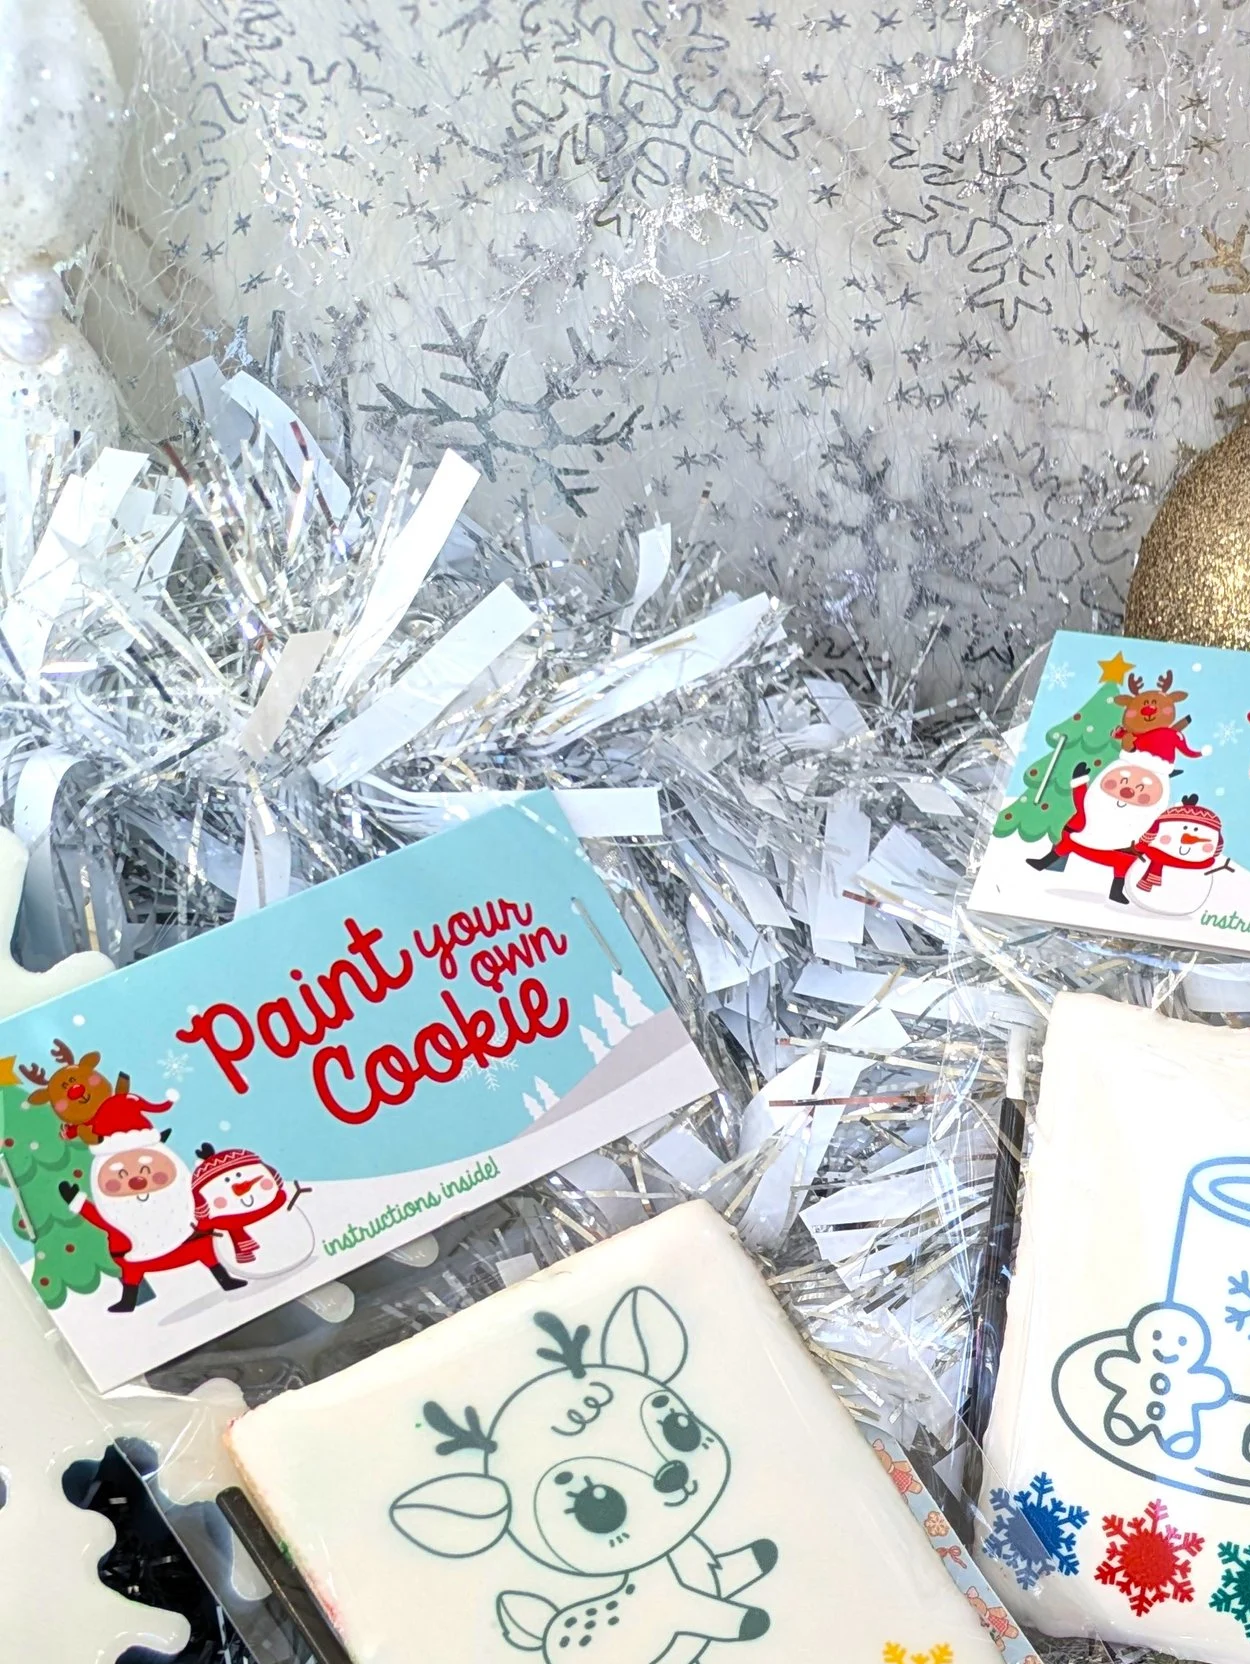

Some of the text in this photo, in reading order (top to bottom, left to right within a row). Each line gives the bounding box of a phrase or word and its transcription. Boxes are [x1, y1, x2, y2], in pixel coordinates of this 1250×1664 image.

[175, 897, 533, 1095] Paint your
[469, 926, 568, 990] own
[311, 977, 570, 1126] Cookie
[322, 1155, 501, 1257] instructions inside!
